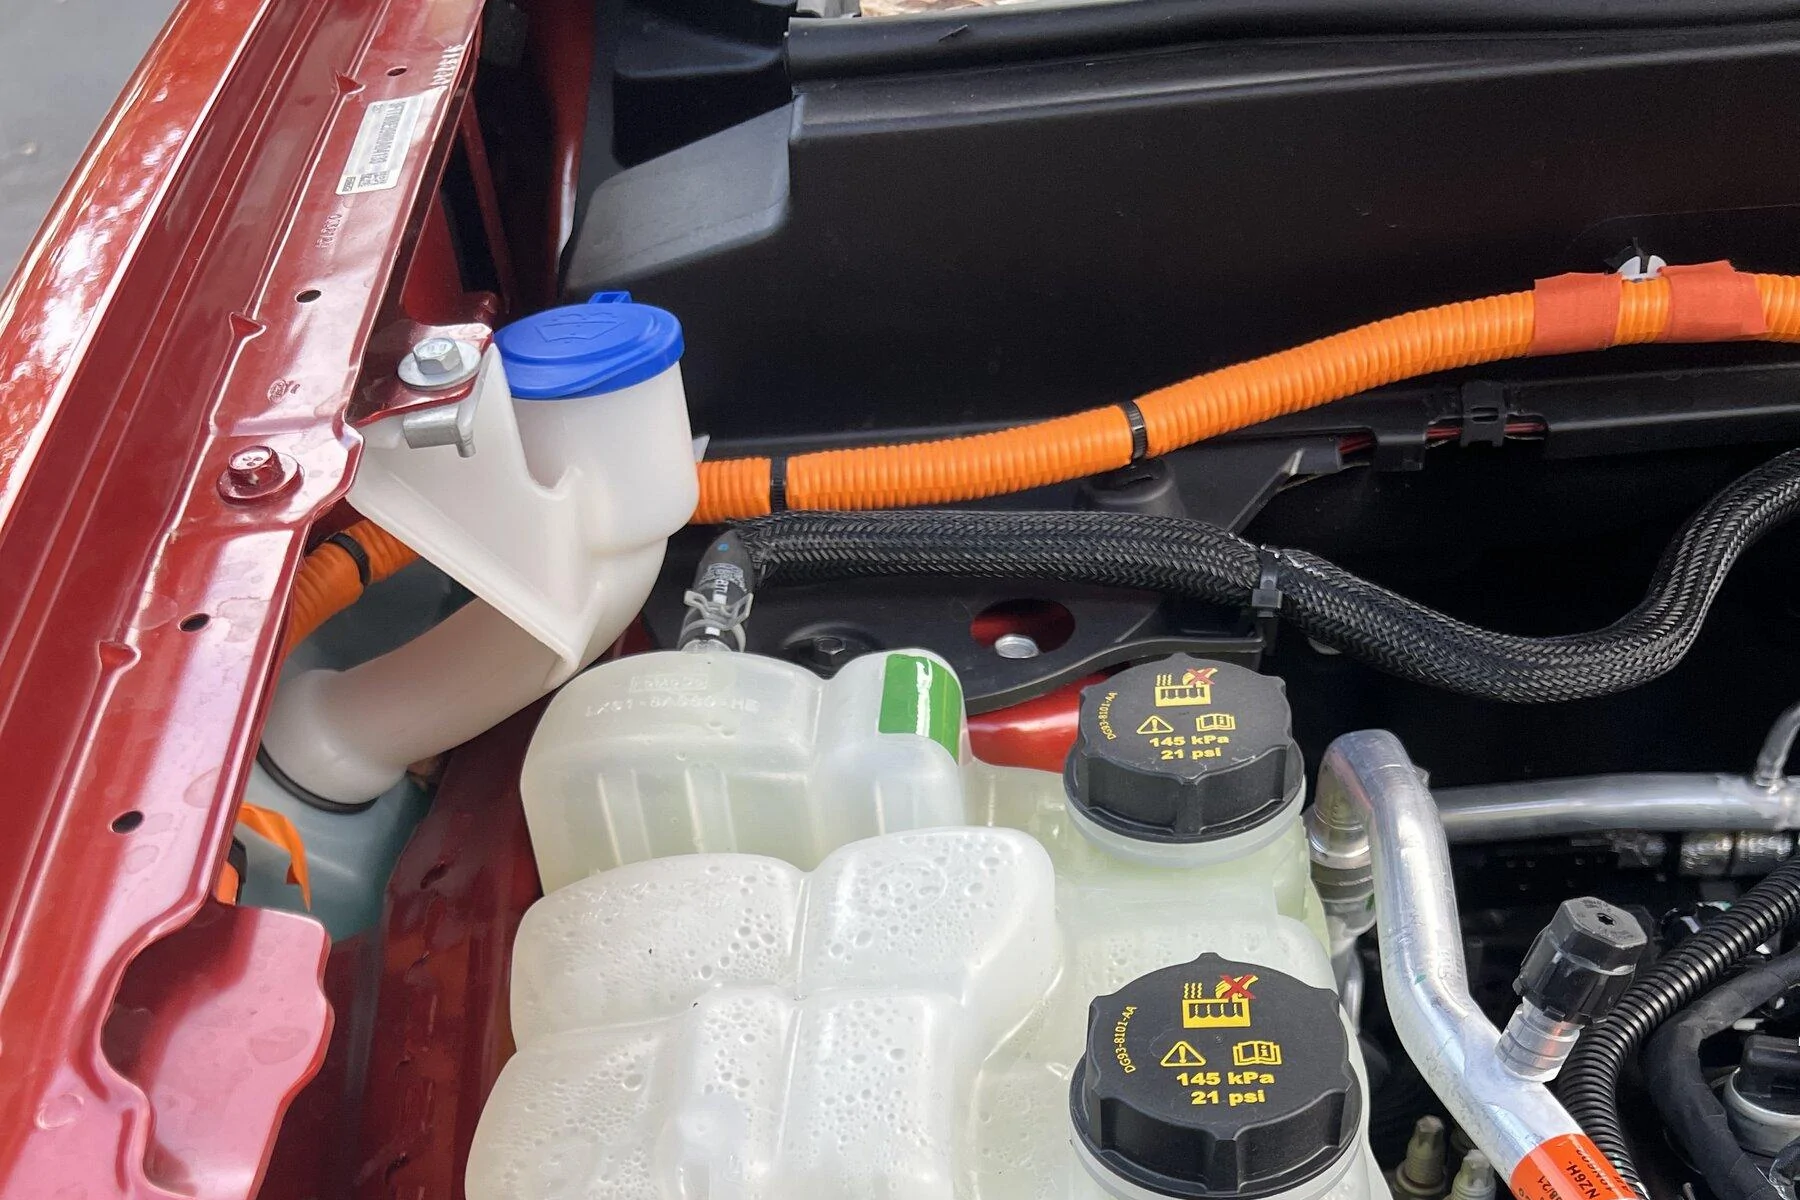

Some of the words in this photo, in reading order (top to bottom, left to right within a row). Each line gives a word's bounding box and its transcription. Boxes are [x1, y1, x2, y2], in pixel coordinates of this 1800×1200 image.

[1149, 736, 1186, 747] 145
[1191, 735, 1230, 746] kPa
[1160, 749, 1185, 760] 21
[1191, 748, 1222, 761] psi
[1112, 1005, 1139, 1075] DG93-8101-AA
[1176, 1072, 1221, 1086] 145
[1228, 1071, 1276, 1085] kPa
[1191, 1091, 1219, 1104] 21
[1229, 1089, 1265, 1107] psi
